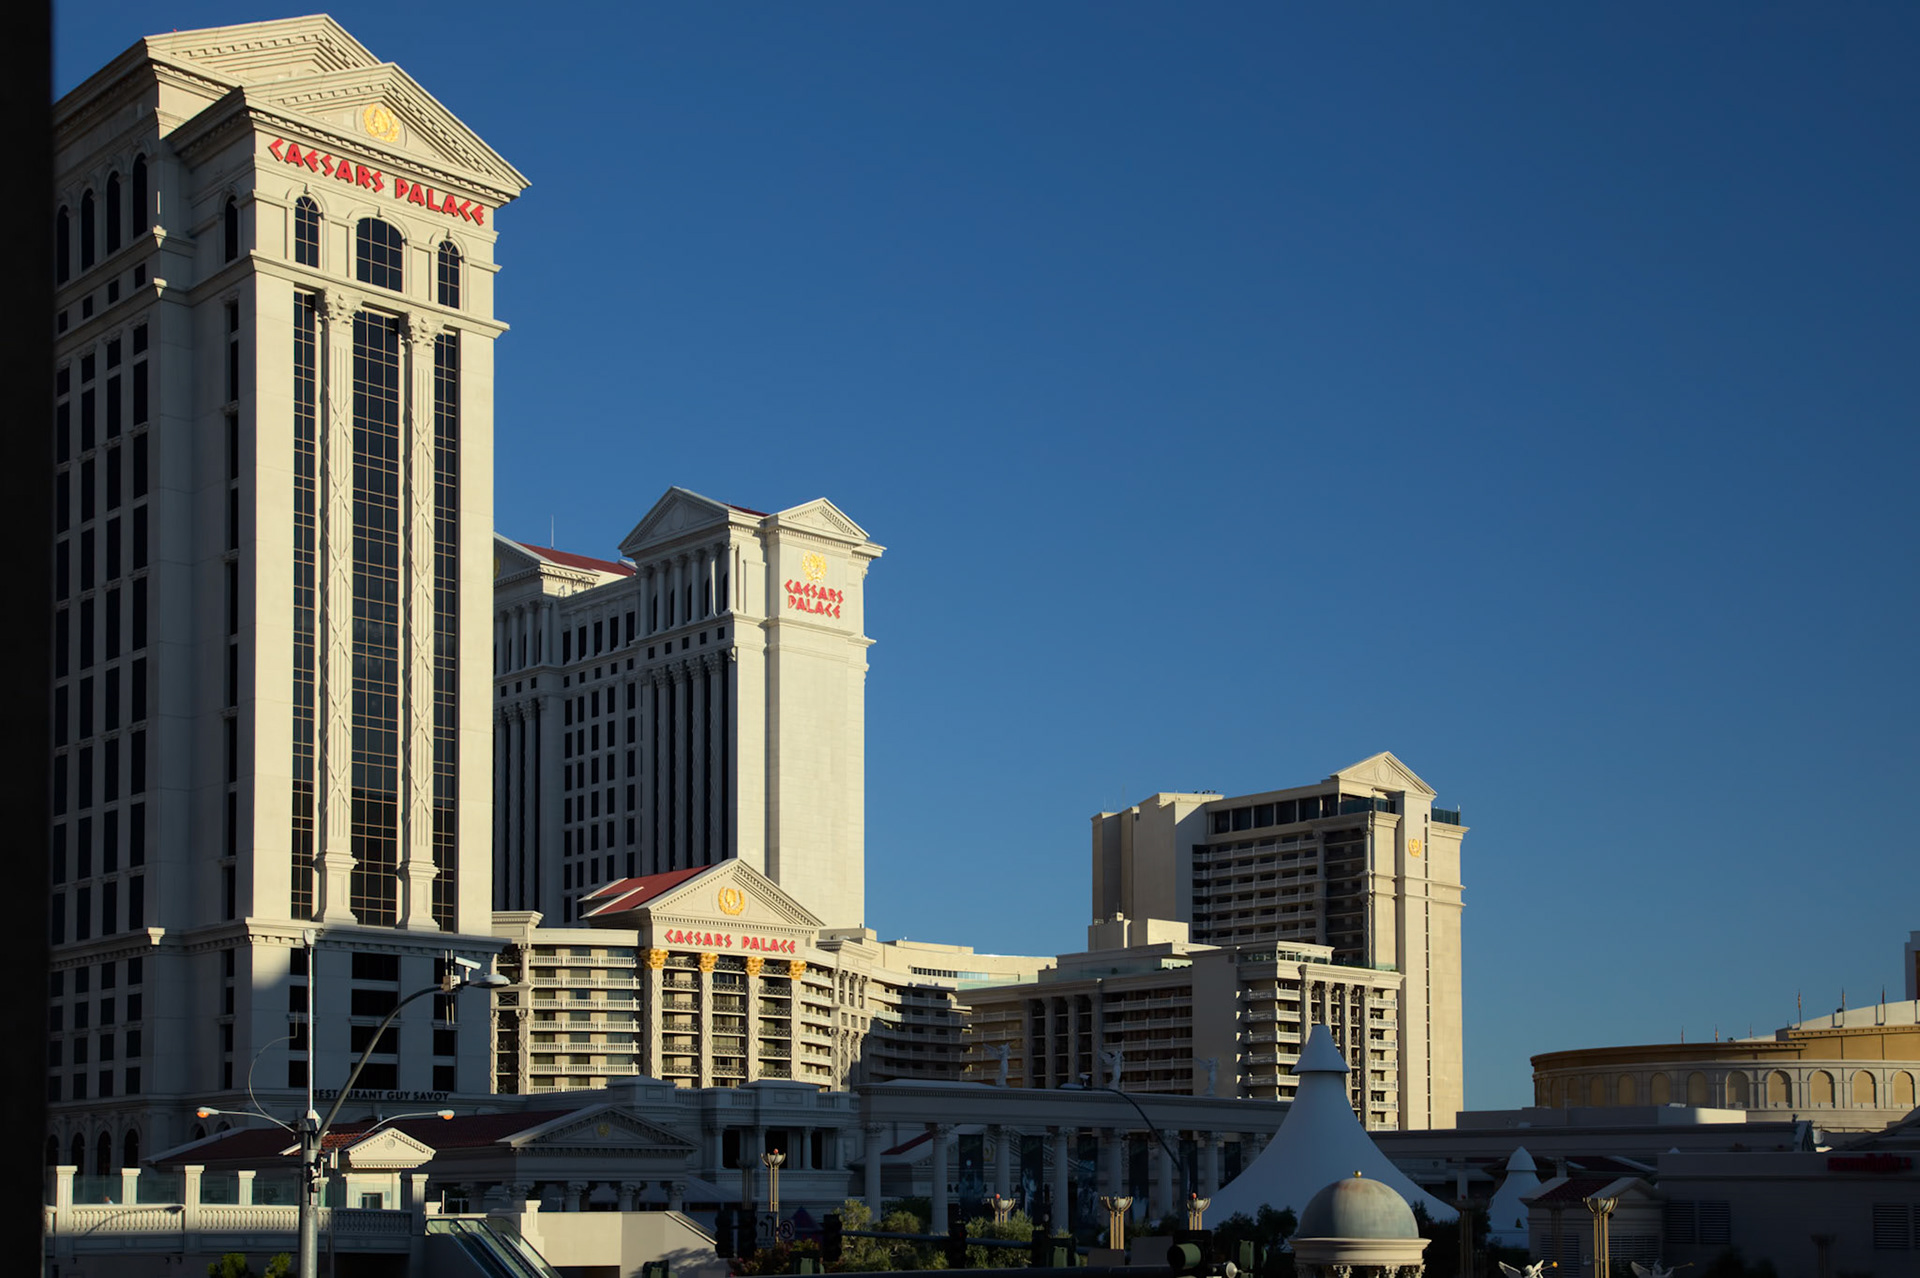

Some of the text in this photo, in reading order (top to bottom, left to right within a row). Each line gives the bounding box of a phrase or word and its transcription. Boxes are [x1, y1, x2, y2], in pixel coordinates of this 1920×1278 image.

[268, 138, 485, 226] CAESARS PALACE
[784, 579, 844, 604] CAESARS
[787, 595, 840, 619] PALACE
[664, 929, 796, 954] CAESARS PALACE
[312, 1088, 450, 1102] RESTURANT GUY SAVOY
